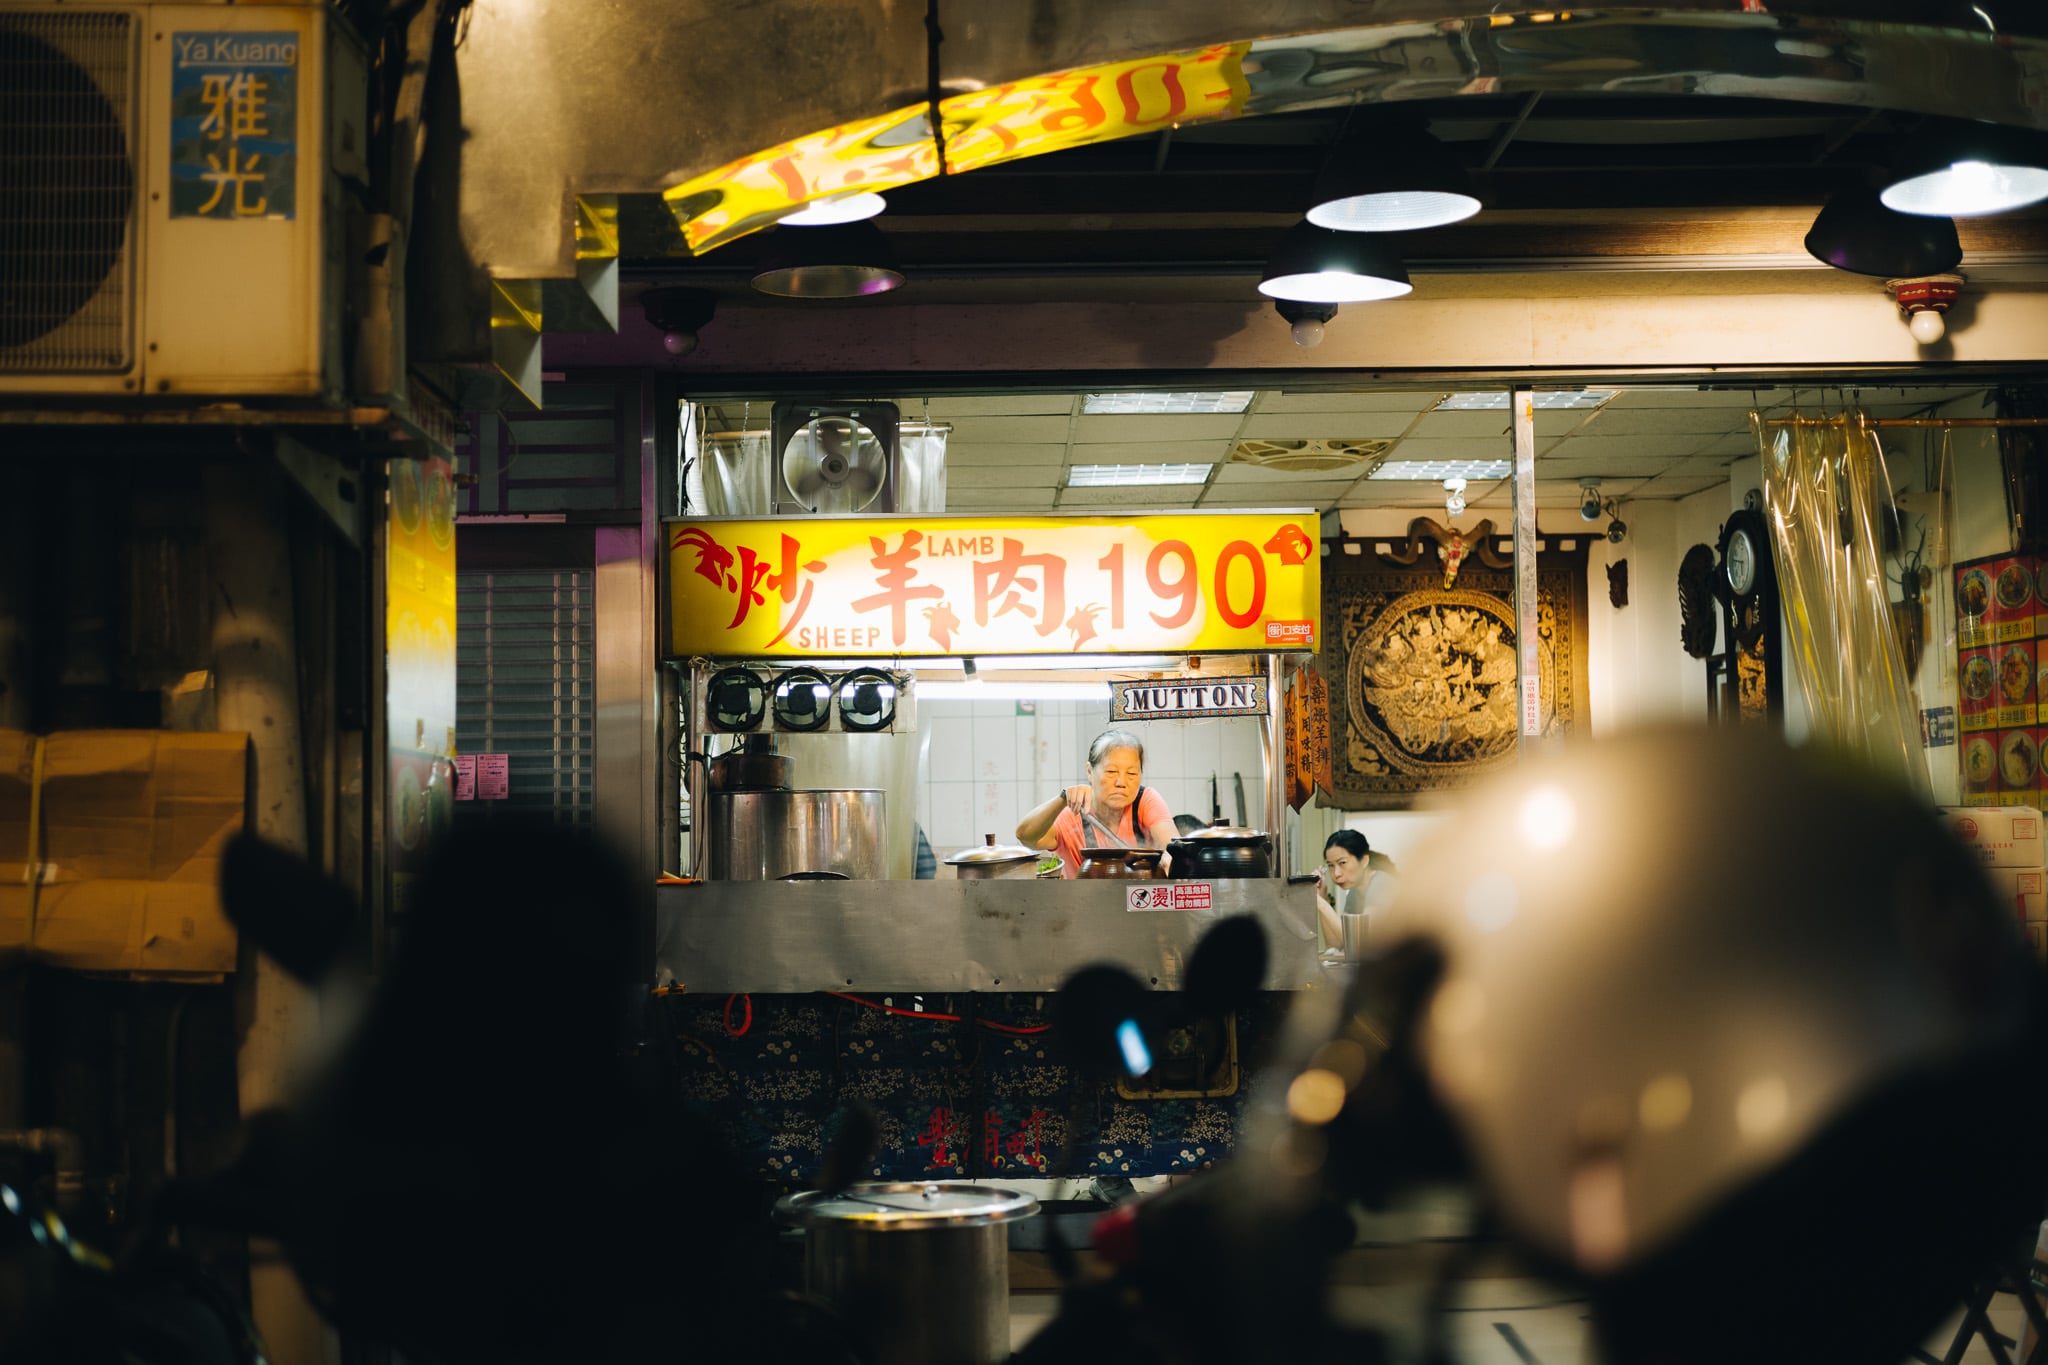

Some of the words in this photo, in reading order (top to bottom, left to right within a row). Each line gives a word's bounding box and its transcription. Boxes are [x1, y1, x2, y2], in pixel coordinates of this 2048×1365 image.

[176, 37, 209, 62] Ya
[213, 37, 297, 66] Kuang
[198, 71, 269, 215] 雅光
[927, 535, 994, 558] LAMB
[726, 528, 1067, 650] 炒羊肉
[1097, 539, 1267, 630] 190
[799, 626, 881, 649] SHEEP
[1132, 685, 1248, 711] MUTTON
[1300, 694, 1313, 774] 不用味精
